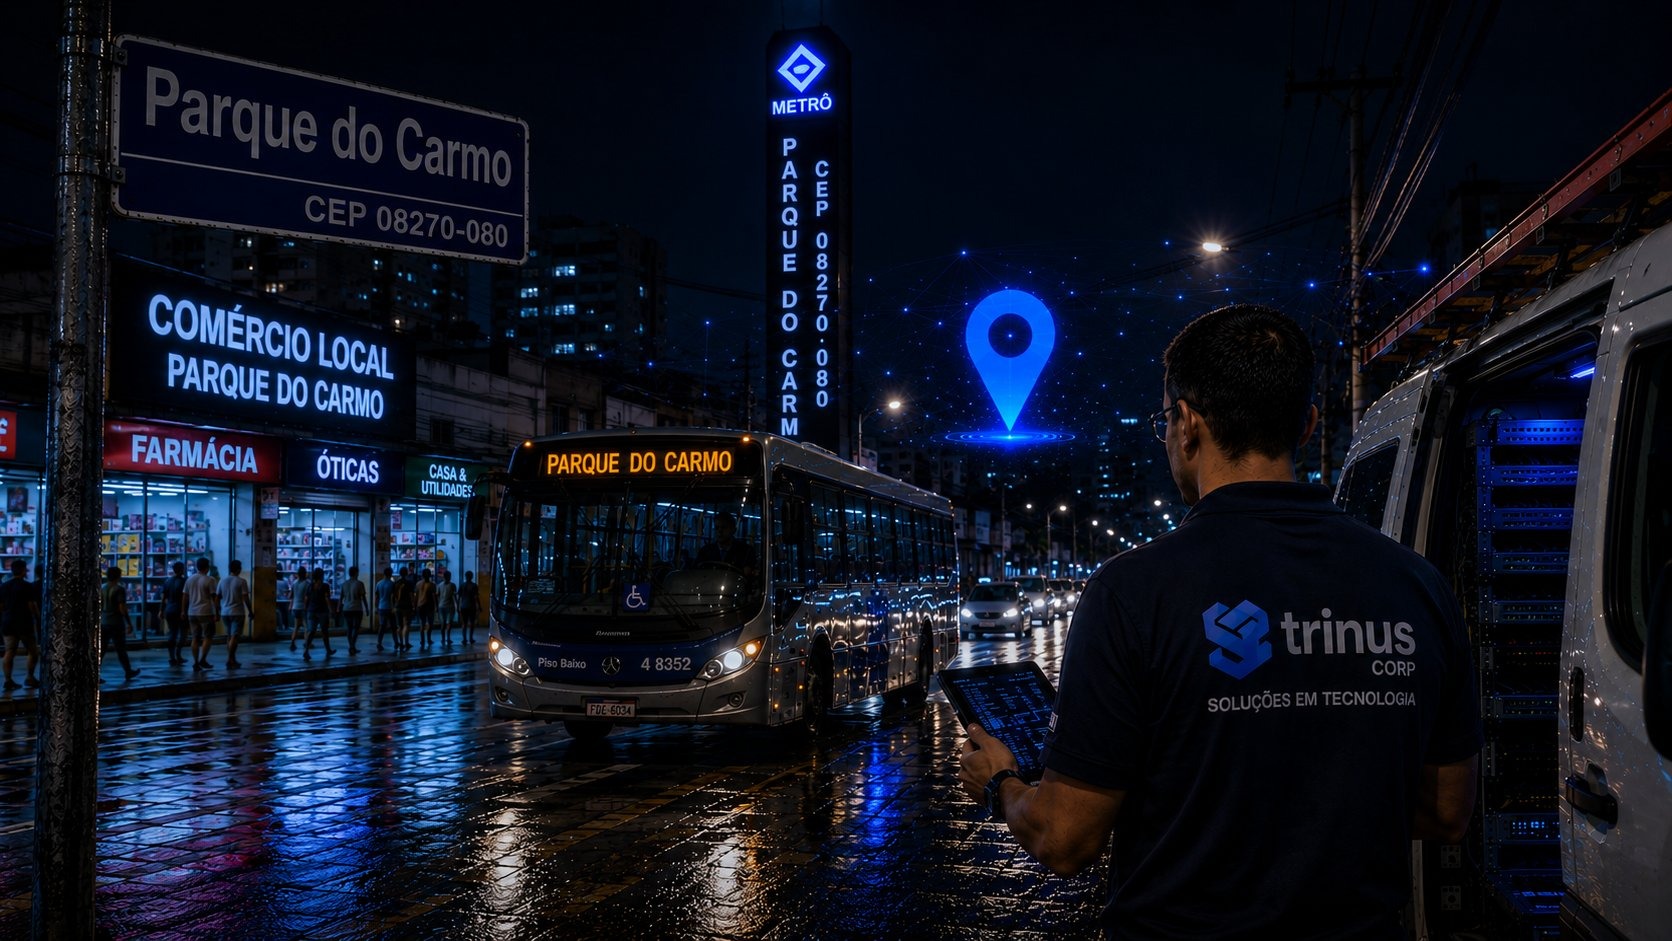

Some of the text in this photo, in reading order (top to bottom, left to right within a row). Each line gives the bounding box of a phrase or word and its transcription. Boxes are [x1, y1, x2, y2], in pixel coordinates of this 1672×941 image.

[771, 91, 833, 116] METRÔ
[145, 65, 513, 188] Parque do Carmo
[814, 160, 830, 217] CEP
[304, 195, 509, 249] CEP 08270-080
[781, 137, 799, 436] PARQUE DO CARM
[147, 293, 395, 381] COMÉRCIO LOCAL
[167, 351, 385, 421] PARQUE DO CARMO
[131, 435, 259, 474] FARMÁCIA
[316, 448, 380, 485] ÓTICAS
[429, 463, 468, 482] CASA &
[547, 450, 733, 475] PARQUE DO CARMO
[421, 479, 476, 499] UTILIDADES
[1280, 607, 1417, 656] trinus
[537, 656, 692, 672] Piso Baixo 4 8352
[1371, 659, 1416, 677] CORP
[1207, 690, 1416, 713] SOLUÇÕES EM TECNOLOGIA
